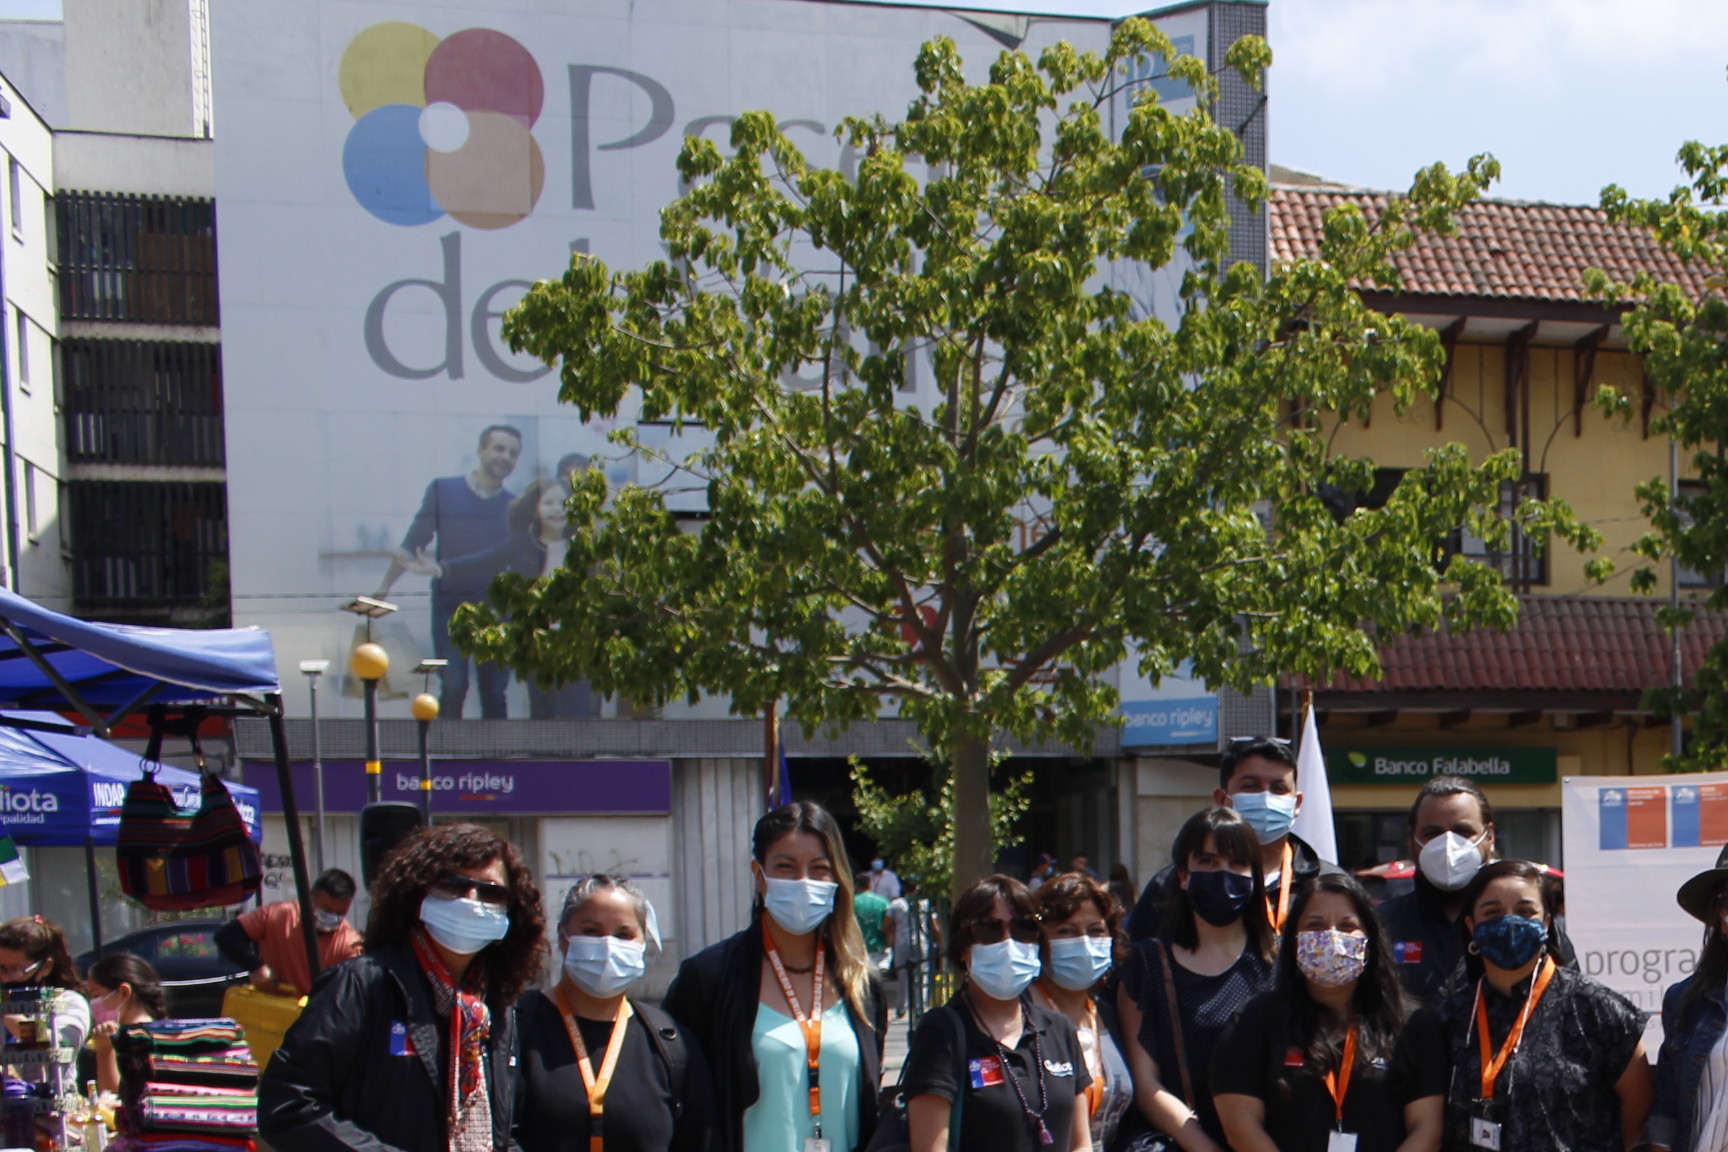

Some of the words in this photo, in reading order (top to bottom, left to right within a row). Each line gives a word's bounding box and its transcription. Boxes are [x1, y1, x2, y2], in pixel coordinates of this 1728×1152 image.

[1170, 707, 1213, 729] ripley
[1374, 757, 1428, 775] Banco
[1432, 757, 1511, 775] Falabella
[397, 772, 455, 791] baco
[458, 772, 514, 793] ripley
[1585, 948, 1696, 984] progra
